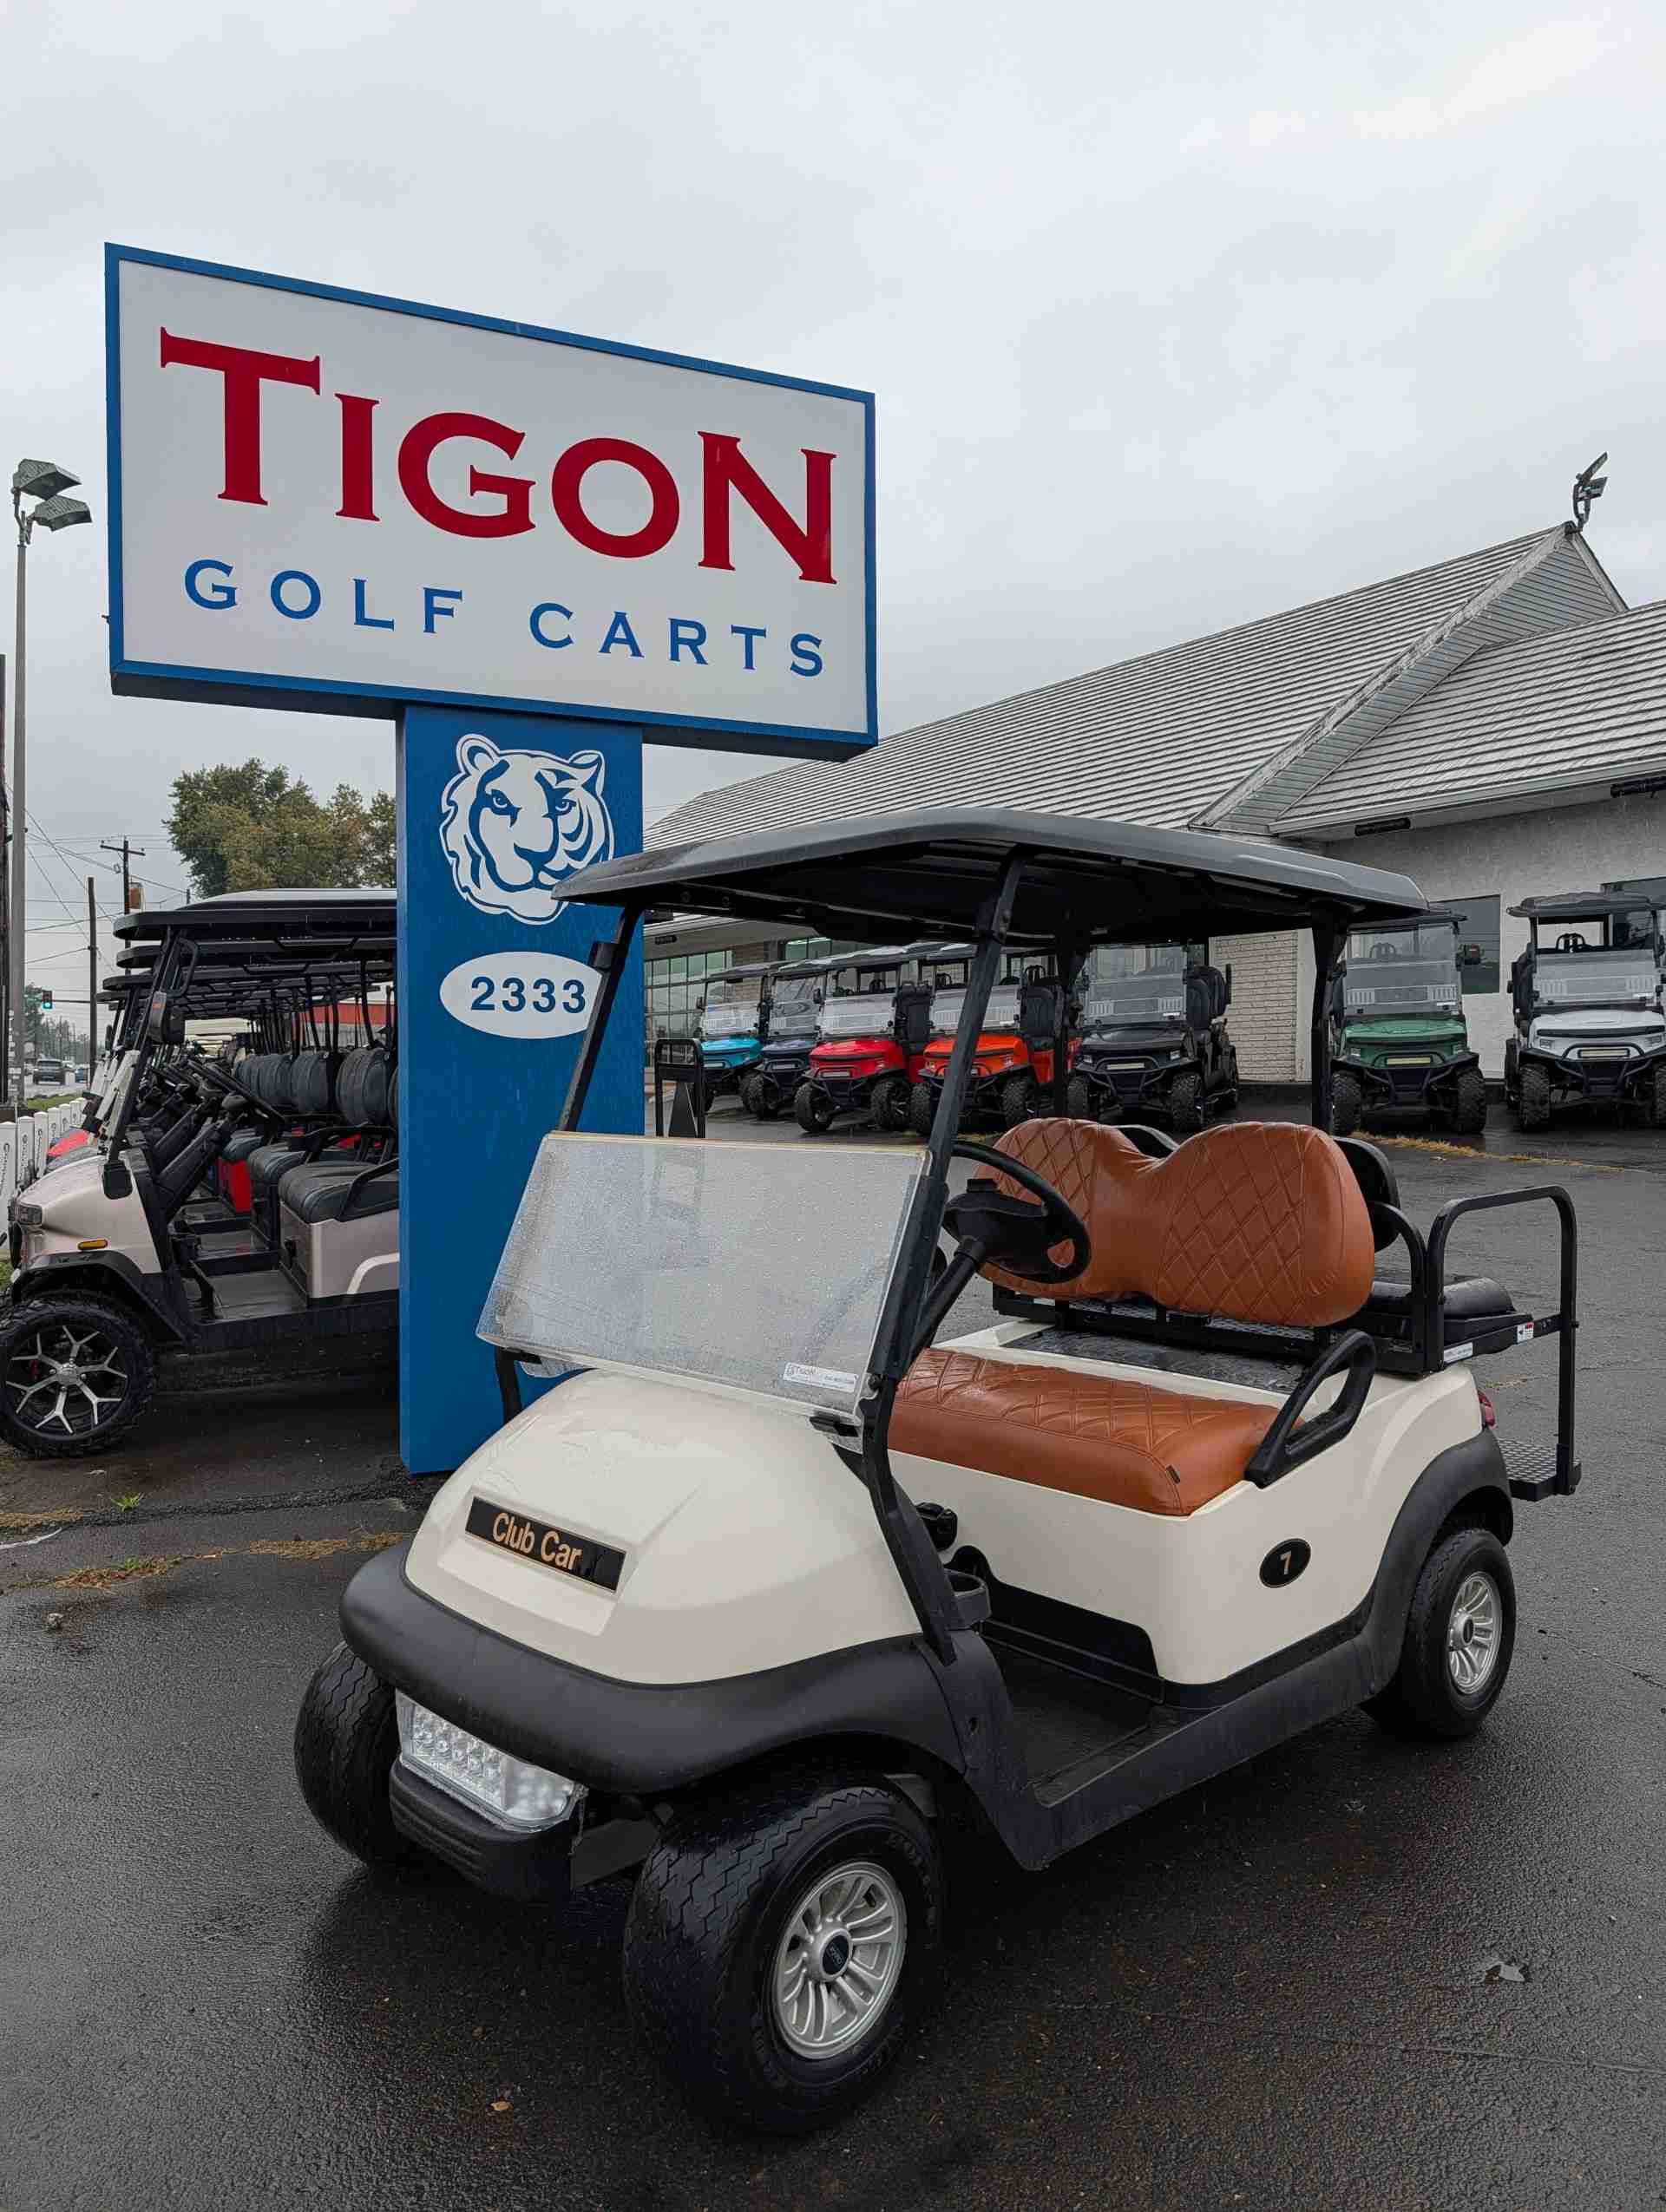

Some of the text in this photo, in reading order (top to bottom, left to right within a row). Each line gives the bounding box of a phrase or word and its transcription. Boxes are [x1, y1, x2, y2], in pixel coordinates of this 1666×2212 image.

[160, 326, 836, 585] TIGON
[184, 559, 825, 677] GOLF CARTS
[470, 975, 587, 1014] 2333
[492, 1512, 584, 1571] Club Car
